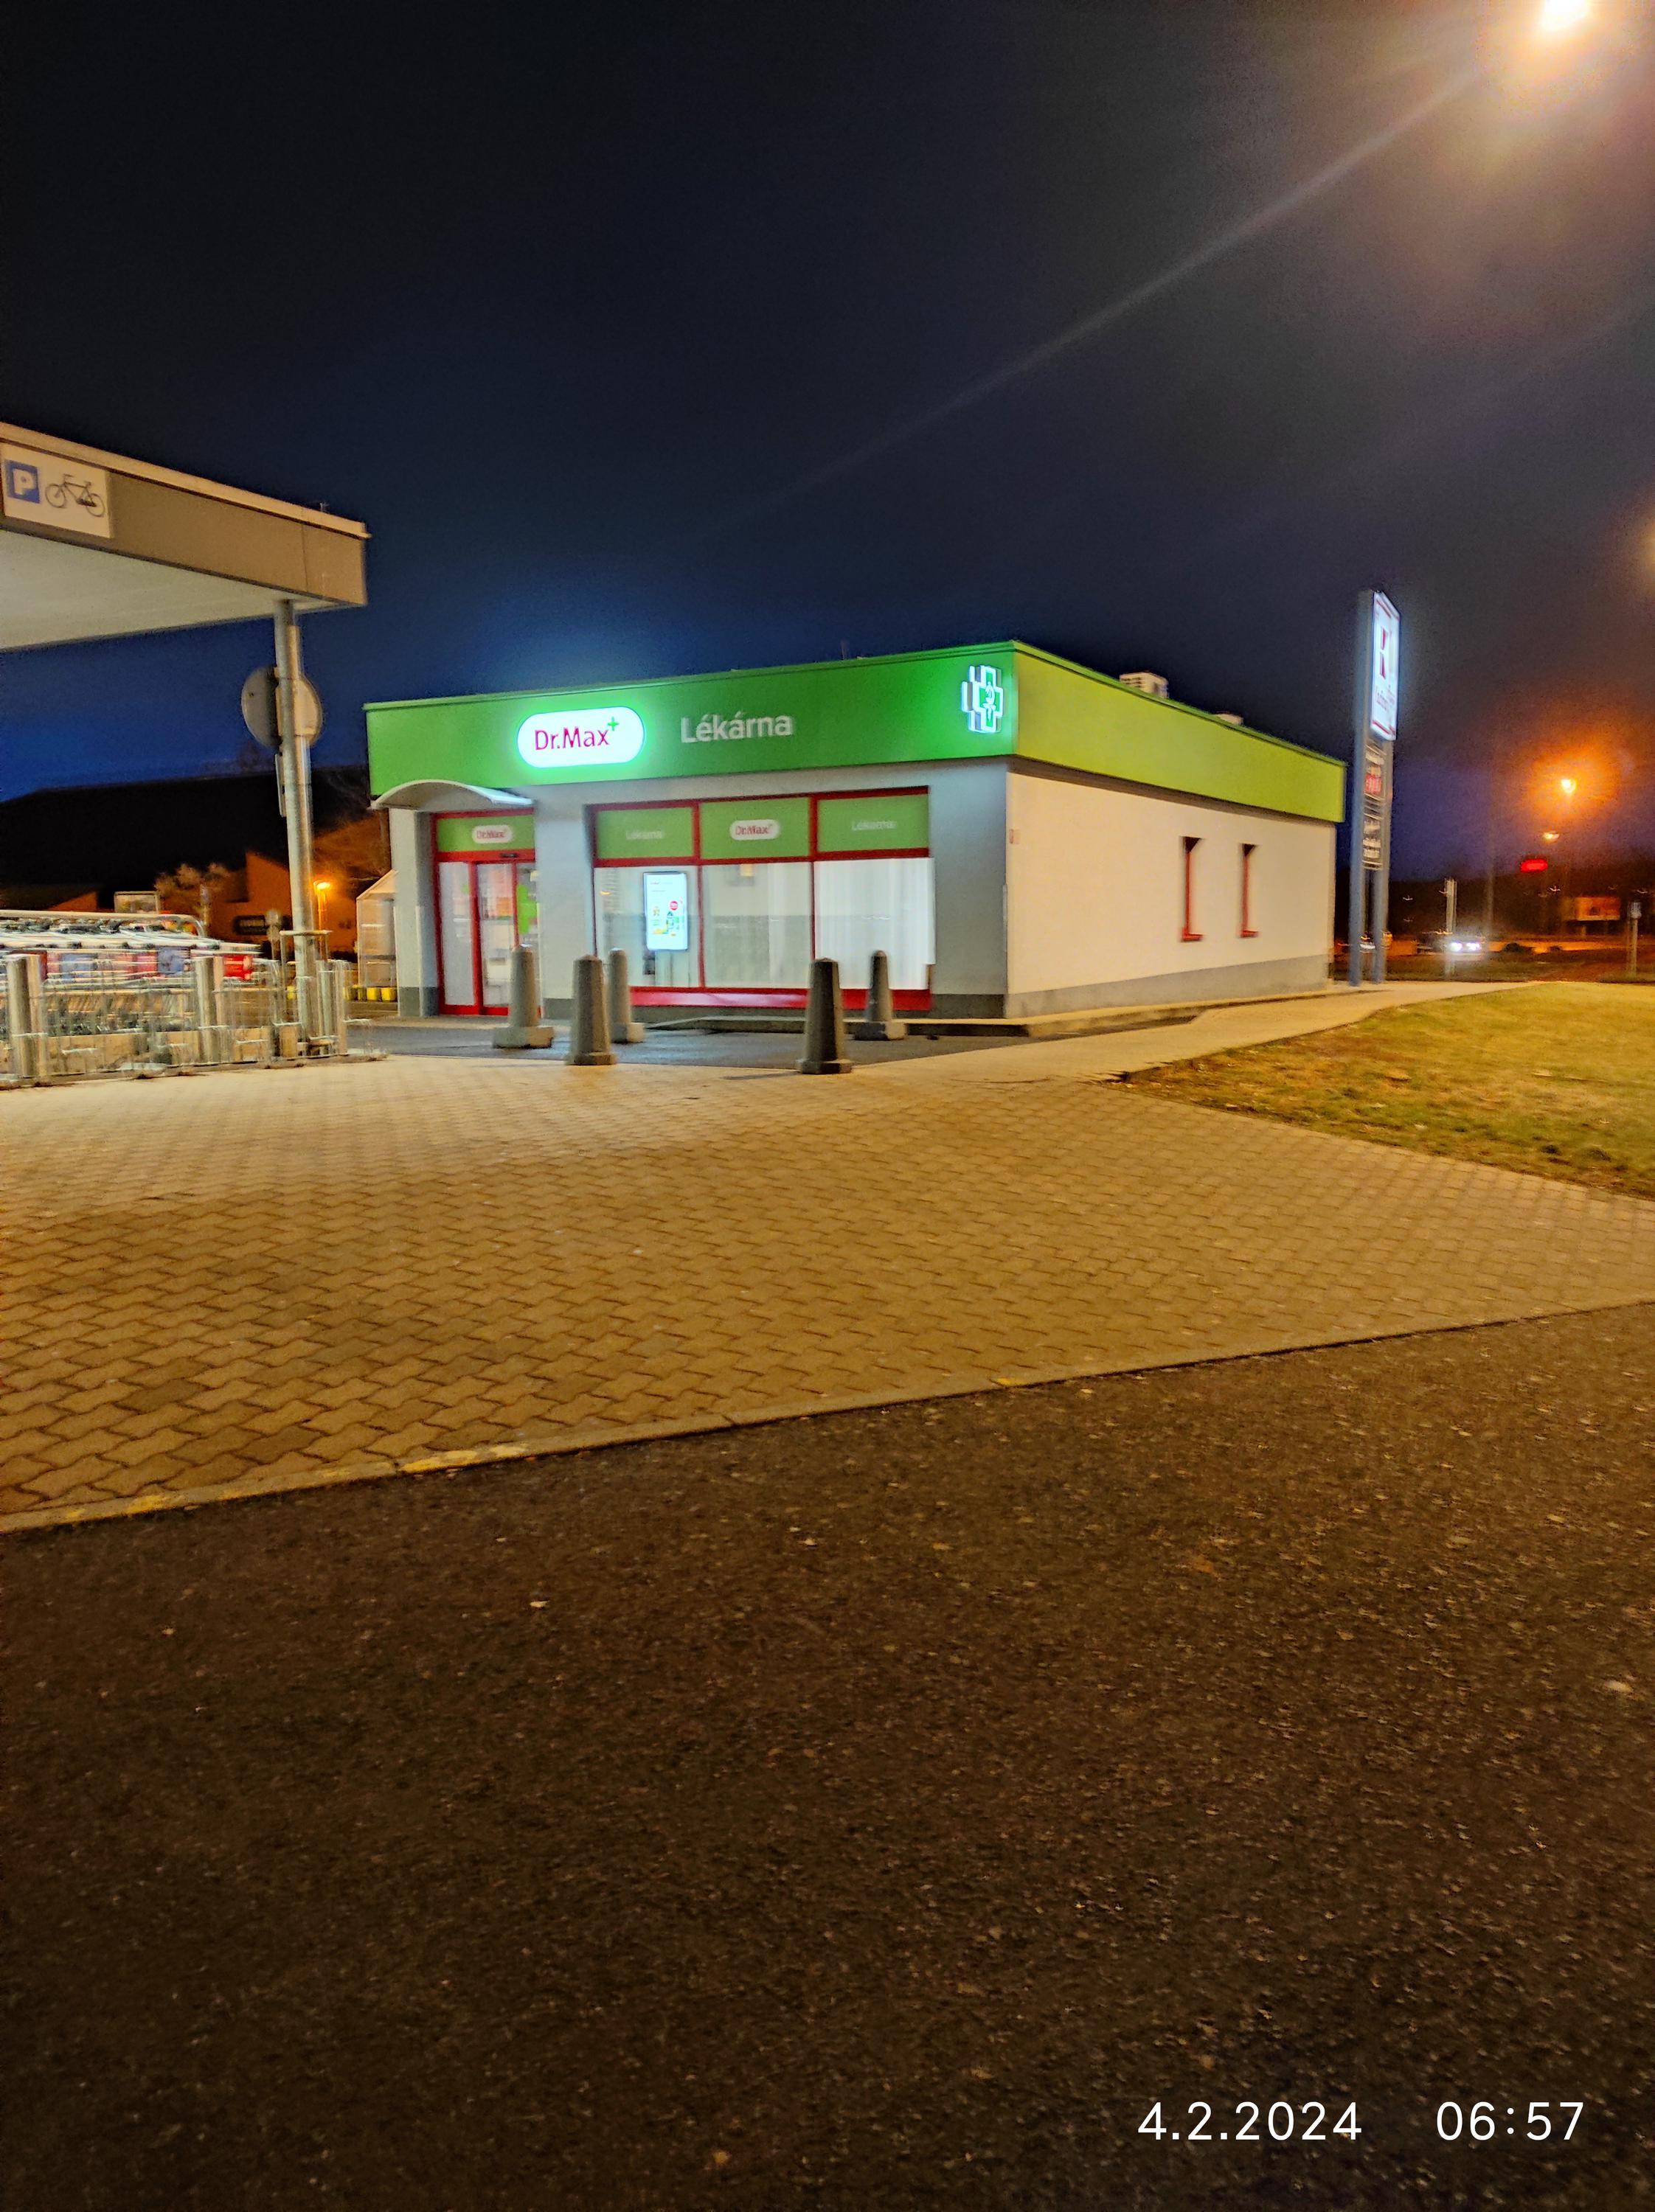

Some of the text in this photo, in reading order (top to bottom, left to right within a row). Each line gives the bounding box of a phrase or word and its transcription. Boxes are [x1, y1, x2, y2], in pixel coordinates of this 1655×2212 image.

[13, 468, 34, 495] P
[535, 726, 611, 751] Dr.Max
[680, 711, 793, 743] Lékárna
